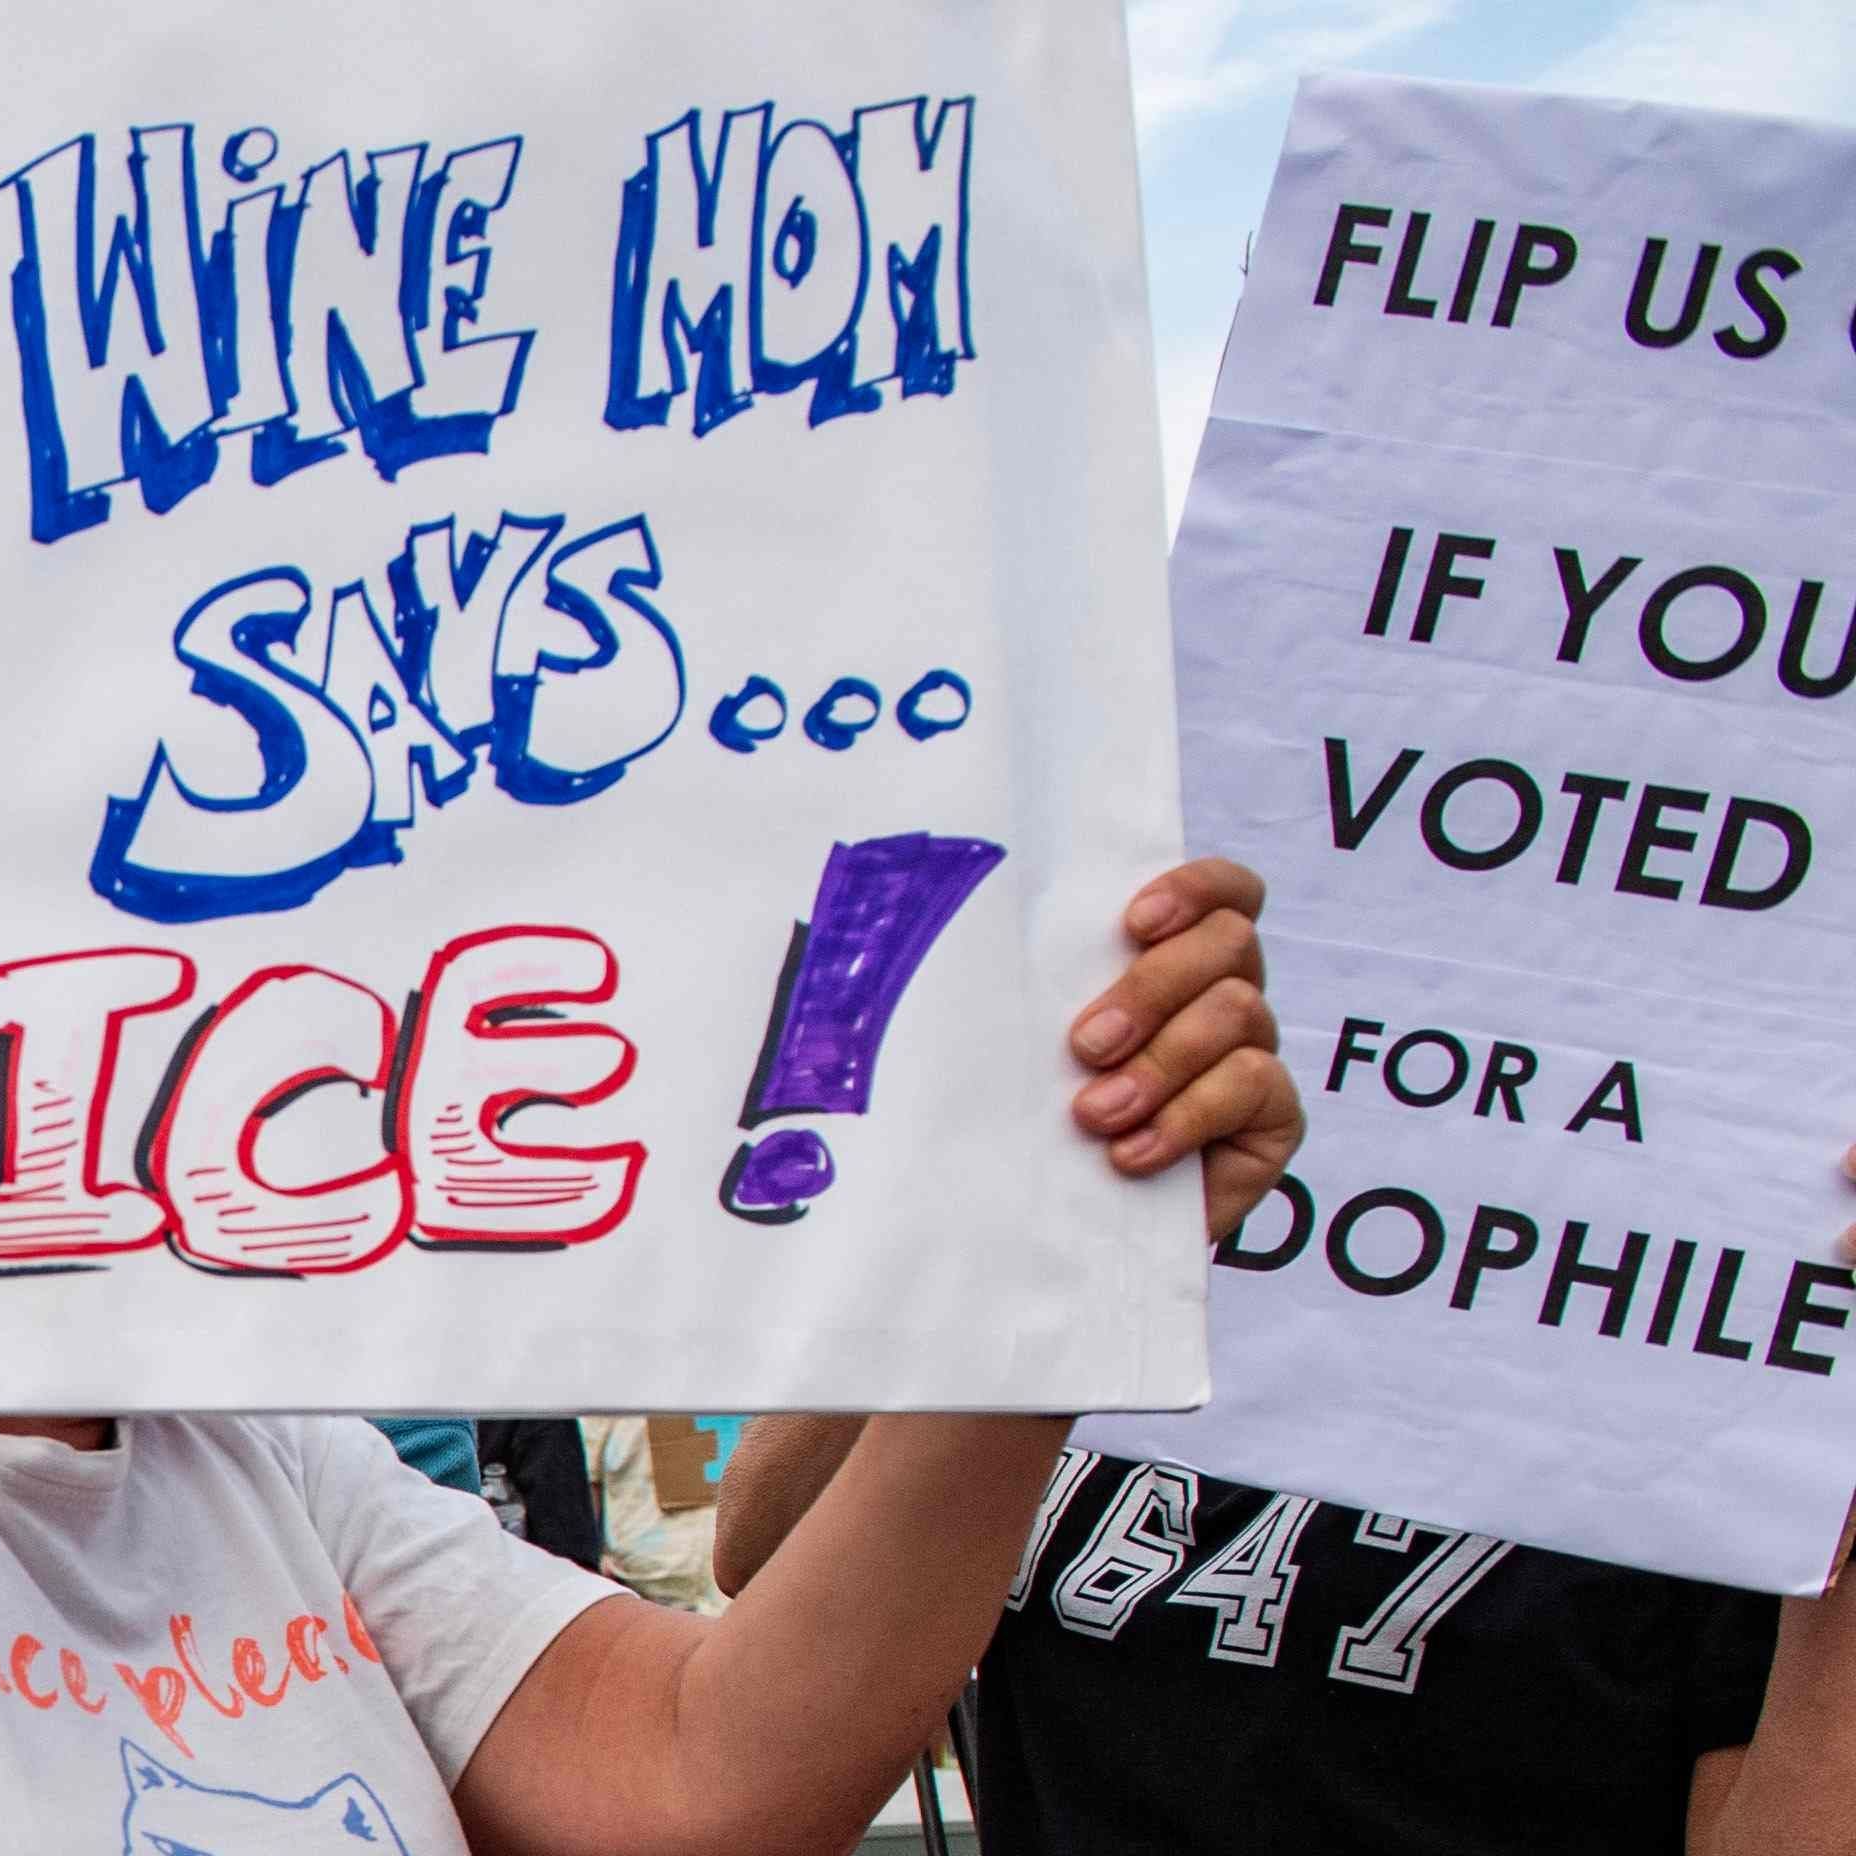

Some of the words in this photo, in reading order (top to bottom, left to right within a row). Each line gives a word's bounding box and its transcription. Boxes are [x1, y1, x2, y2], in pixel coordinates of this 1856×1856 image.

[601, 95, 978, 440] MOM
[1313, 203, 1577, 328] FLIP
[1626, 237, 1802, 359] US
[1363, 527, 1496, 643] IF
[1553, 547, 1856, 699] YOU
[1323, 737, 1812, 911] VOTED
[1325, 1017, 1538, 1124] FOR
[1564, 1060, 1643, 1143] A
